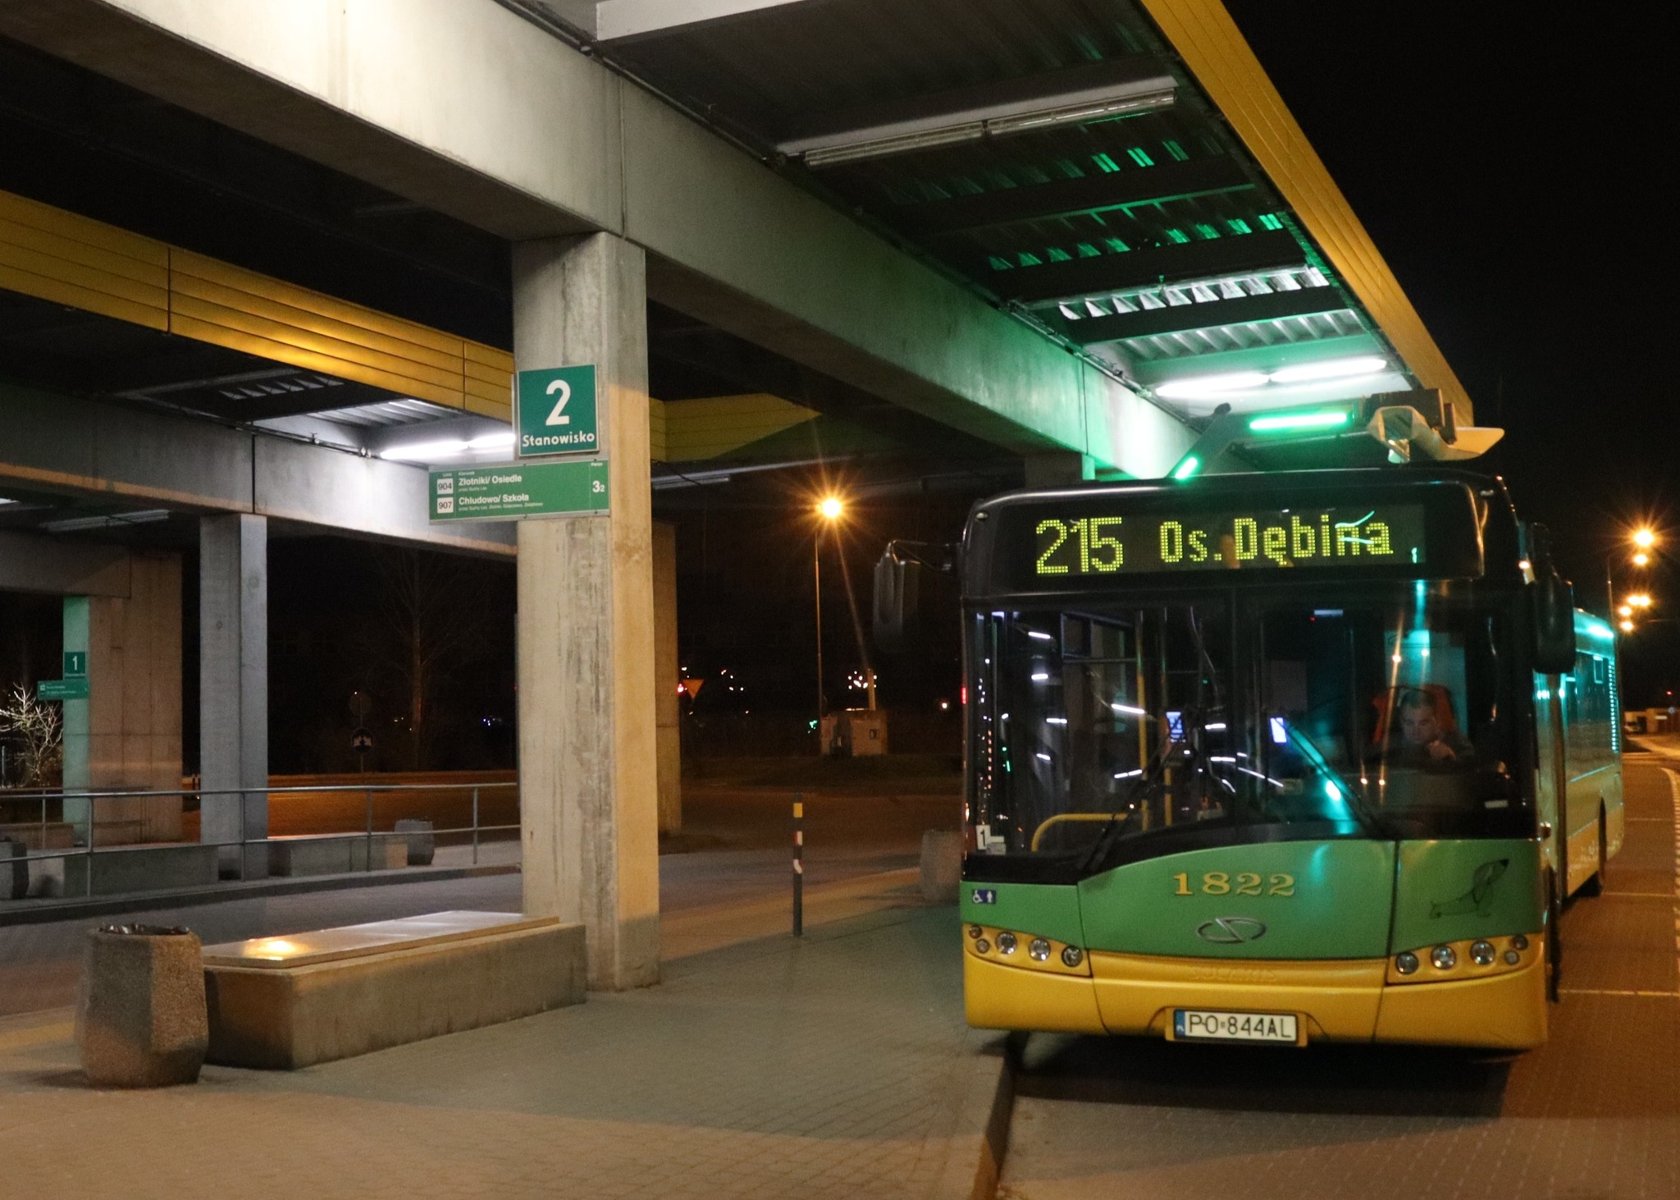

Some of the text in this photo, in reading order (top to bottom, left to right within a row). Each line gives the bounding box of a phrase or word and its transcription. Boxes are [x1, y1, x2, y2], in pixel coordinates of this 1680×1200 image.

[545, 379, 571, 426] 2
[522, 430, 595, 448] Stanowisko
[438, 482, 453, 491] 904
[491, 475, 523, 485] Osiedle
[438, 501, 453, 510] 907
[1036, 514, 1394, 575] 215 Os. Dębina
[72, 655, 78, 671] 1
[1173, 872, 1295, 896] 1822
